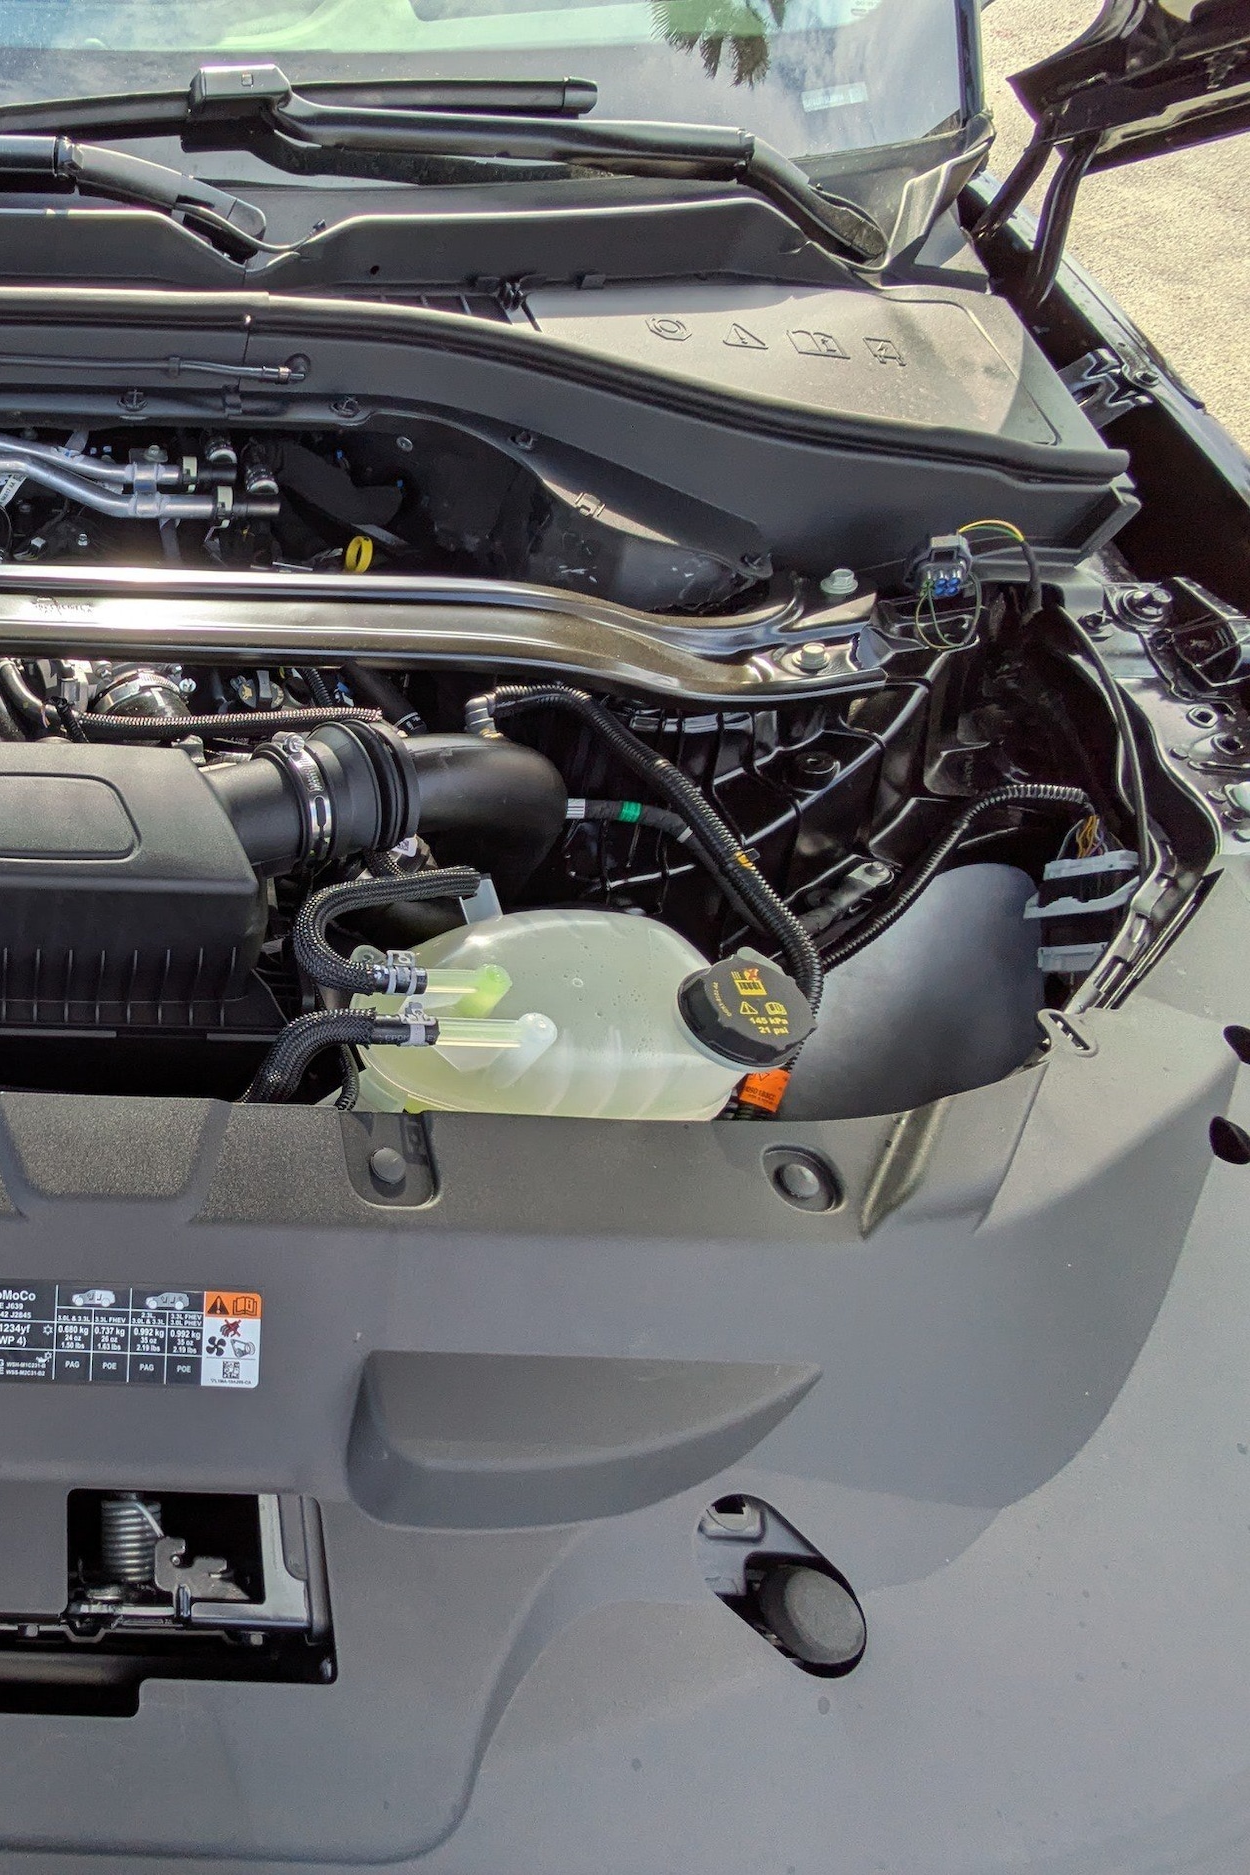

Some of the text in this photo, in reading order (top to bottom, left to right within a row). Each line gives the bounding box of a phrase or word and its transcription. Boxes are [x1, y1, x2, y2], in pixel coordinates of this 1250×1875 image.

[773, 1027, 789, 1035] psi
[58, 1325, 89, 1336] 0.680 kg
[95, 1327, 125, 1337] 0.737 kg
[134, 1328, 164, 1338] 0.992 kg
[170, 1330, 201, 1340] 0.992 kg
[17, 1336, 26, 1347] 4)
